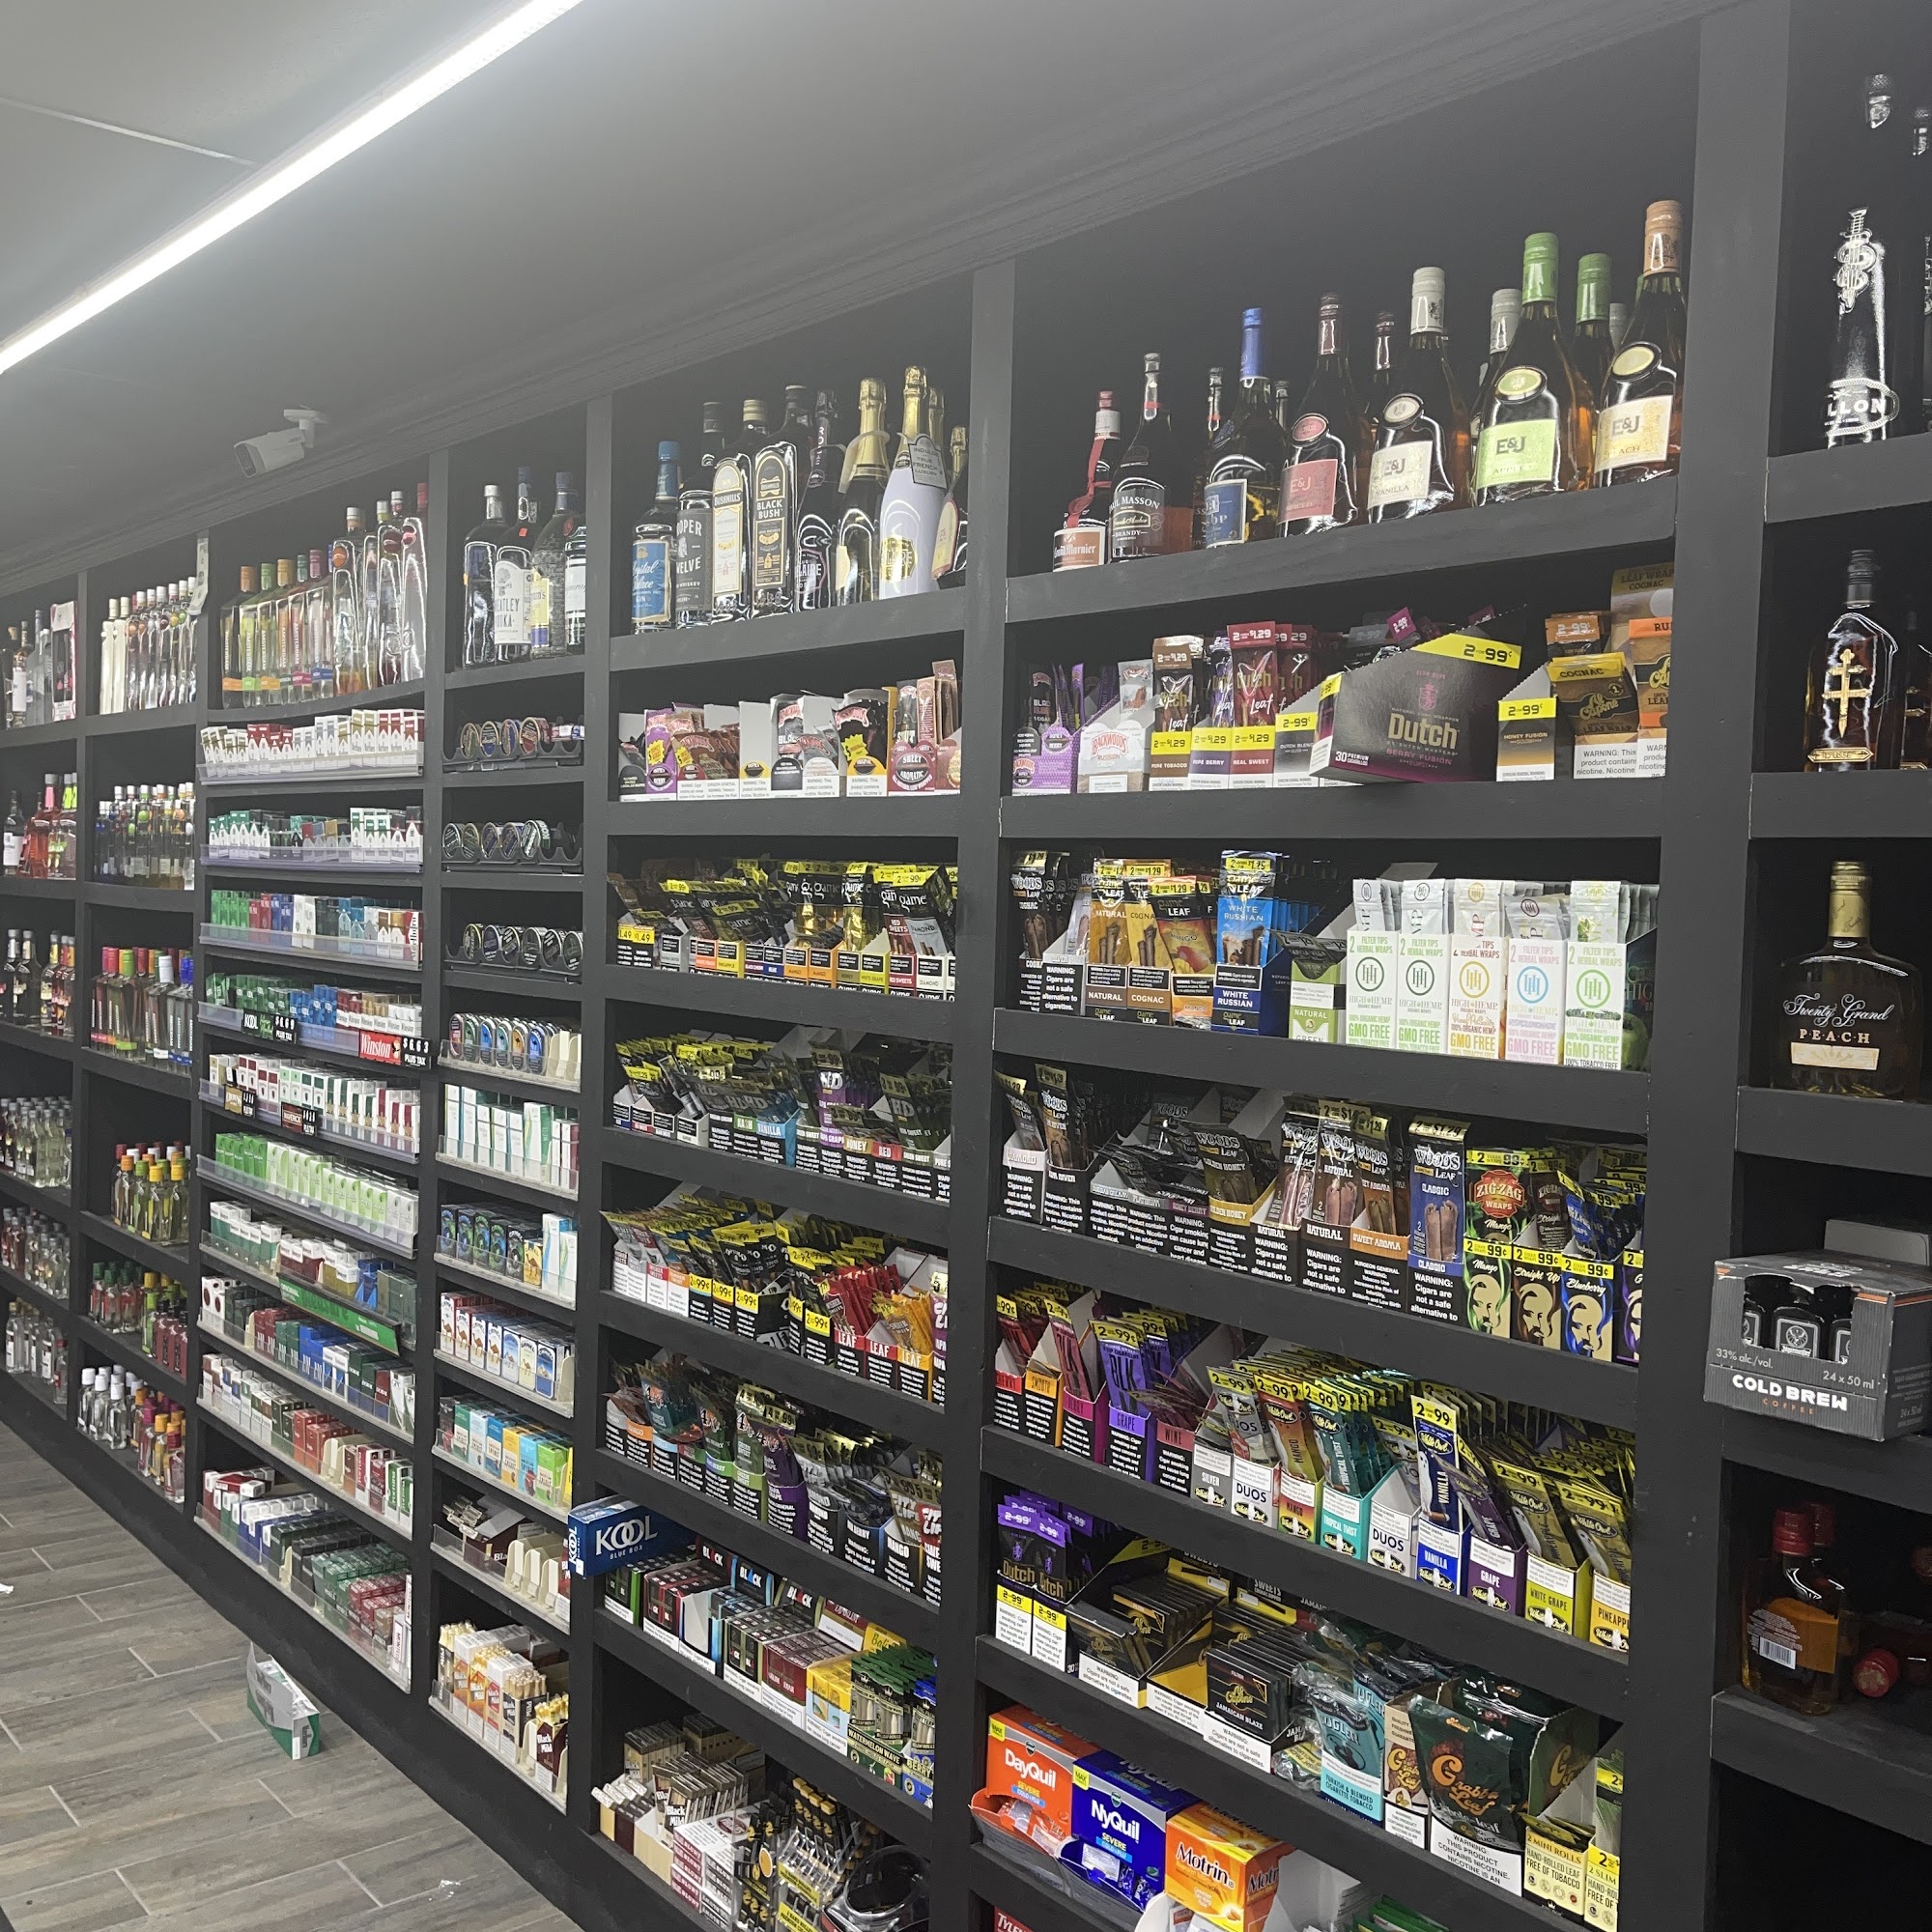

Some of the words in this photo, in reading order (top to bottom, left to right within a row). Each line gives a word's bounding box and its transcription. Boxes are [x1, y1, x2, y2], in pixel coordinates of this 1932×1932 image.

[1612, 415, 1640, 436] E&J
[1496, 437, 1526, 455] E&J
[1384, 458, 1406, 475] E&J
[1291, 476, 1312, 493] E&J
[1375, 485, 1409, 496] VANILLA
[714, 493, 742, 506] BUSHMILLS
[757, 499, 782, 510] BLACK
[1122, 497, 1159, 509] MASSON
[758, 508, 781, 519] BUSH
[1629, 581, 1663, 590] COGNAC
[1463, 643, 1475, 657] 2
[1486, 645, 1513, 663] 99¢
[1560, 668, 1605, 678] COGNAC
[1250, 694, 1273, 715] Leaf
[1579, 698, 1619, 720] Capone
[1169, 714, 1188, 731] Leaf
[1388, 712, 1458, 749] Dutch
[1092, 732, 1128, 755] BACKWOODS
[1335, 752, 1347, 762] 30
[1386, 748, 1416, 758] BERRY
[1419, 753, 1452, 765] FUSION
[1581, 758, 1606, 767] product
[899, 895, 927, 913] game
[1131, 995, 1164, 1004] COGNAC
[1217, 998, 1253, 1008] RUSSIAN
[1222, 990, 1249, 999] WHITE
[1294, 1009, 1328, 1019] NATURAL
[1783, 992, 1837, 1027] Twenty
[1833, 994, 1895, 1027] Grand
[284, 1033, 293, 1041] TAX
[360, 1033, 391, 1058] Winston
[1451, 1033, 1470, 1048] GMO
[1473, 1036, 1495, 1051] FREE
[1508, 1037, 1528, 1053] GMO
[1531, 1039, 1555, 1056] FREE
[1566, 1041, 1589, 1058] GMO
[1593, 1044, 1618, 1061] FREE
[404, 1053, 415, 1063] PLUS
[416, 1056, 426, 1065] TAX
[892, 1098, 915, 1116] HD
[757, 1123, 781, 1137] VANILLA
[847, 1139, 867, 1151] HONEY
[1194, 1132, 1240, 1149] WOODS
[879, 1147, 892, 1157] RED
[1355, 1142, 1388, 1166] WOODS
[1414, 1146, 1461, 1171] WOODS
[1476, 1182, 1522, 1201] ZIG-ZAG
[1485, 1200, 1513, 1211] WRAPS
[1170, 1224, 1184, 1234] Cigar
[1258, 1226, 1286, 1238] NATURAL
[1307, 1224, 1343, 1242] NATURAL
[1484, 1218, 1513, 1231] Mango
[1352, 1234, 1374, 1246] SWEET
[1375, 1236, 1402, 1252] AROMA
[1255, 1248, 1276, 1259] Cigars
[1251, 1267, 1283, 1280] alternative
[1418, 1259, 1446, 1273] CLASSIC
[1473, 1259, 1498, 1273] Mango
[1514, 1266, 1545, 1281] Straight
[1414, 1272, 1454, 1289] WARNING:
[1566, 1277, 1606, 1296] Blueberry
[1415, 1284, 1438, 1297] Cigars
[1439, 1289, 1453, 1299] are
[1410, 1304, 1448, 1321] alternative
[1449, 1313, 1459, 1322] to
[838, 1335, 857, 1348] LEAF
[870, 1342, 889, 1357] LEAF
[902, 1353, 922, 1367] LEAF
[1716, 1348, 1738, 1361] 33%
[1739, 1354, 1774, 1369] alc./vol.
[1822, 1370, 1836, 1380] 24
[1838, 1376, 1845, 1384] x
[1846, 1376, 1861, 1387] 50
[1862, 1378, 1874, 1389] ml
[1731, 1374, 1782, 1397] COLD
[1786, 1385, 1847, 1411] BREW
[1763, 1398, 1815, 1415] COFFEE
[1117, 1413, 1136, 1432] GRAPE
[1164, 1428, 1182, 1445] WINE
[1436, 1438, 1452, 1453] Owl
[1202, 1472, 1220, 1487] SILVER
[1497, 1464, 1509, 1477] 2
[1518, 1471, 1540, 1487] 99¢
[1236, 1483, 1267, 1502] DUOS
[1438, 1469, 1449, 1504] VANILLA
[1286, 1501, 1304, 1517] MANGO
[1323, 1515, 1342, 1531] TROPICAL
[1343, 1524, 1357, 1537] TWIST
[596, 1515, 658, 1556] KOOL
[1373, 1527, 1405, 1552] DUOS
[610, 1550, 626, 1560] BLUE
[629, 1545, 643, 1553] BOX
[887, 1537, 910, 1558] MANGO
[1424, 1549, 1448, 1571] VANILLA
[1003, 1559, 1035, 1583] Dutch
[1481, 1570, 1500, 1588] GRAPE
[1531, 1588, 1547, 1605] WHITE
[1548, 1595, 1568, 1611] GRAPE
[1087, 1667, 1101, 1679] Cigars
[1226, 1692, 1253, 1709] Capone
[1215, 1702, 1244, 1721] JAMAICAN
[1245, 1716, 1264, 1730] BLAZE
[1223, 1728, 1248, 1745] WARNING:
[848, 1728, 883, 1755] WATERMELON
[883, 1748, 900, 1765] WAVE
[1005, 1747, 1057, 1790] DayQuil
[1239, 1751, 1264, 1768] cigarettes.
[906, 1760, 933, 1779] BERRY
[1075, 1770, 1088, 1783] MAX
[1432, 1754, 1498, 1800] Grabba
[1017, 1779, 1041, 1799] SEVERE
[1325, 1782, 1351, 1801] CIGARETTE
[1352, 1795, 1374, 1810] TOBACCO
[667, 1806, 685, 1815] Black
[669, 1817, 684, 1826] Mild
[1091, 1799, 1141, 1845] NyQuil
[1101, 1833, 1127, 1852] SEVERE
[1453, 1834, 1488, 1855] WARNING:
[1447, 1838, 1462, 1849] THIS
[1463, 1845, 1498, 1866] PRODUCT
[1438, 1843, 1472, 1863] CONTAINS
[1474, 1859, 1510, 1880] NICOTINE.
[1448, 1856, 1480, 1876] NICOTINE
[1491, 1875, 1501, 1885] AN
[1527, 1848, 1564, 1873] HAND-ROLLED
[1566, 1864, 1580, 1877] LEAF
[1588, 1889, 1603, 1904] FREE
[1605, 1899, 1614, 1909] OF
